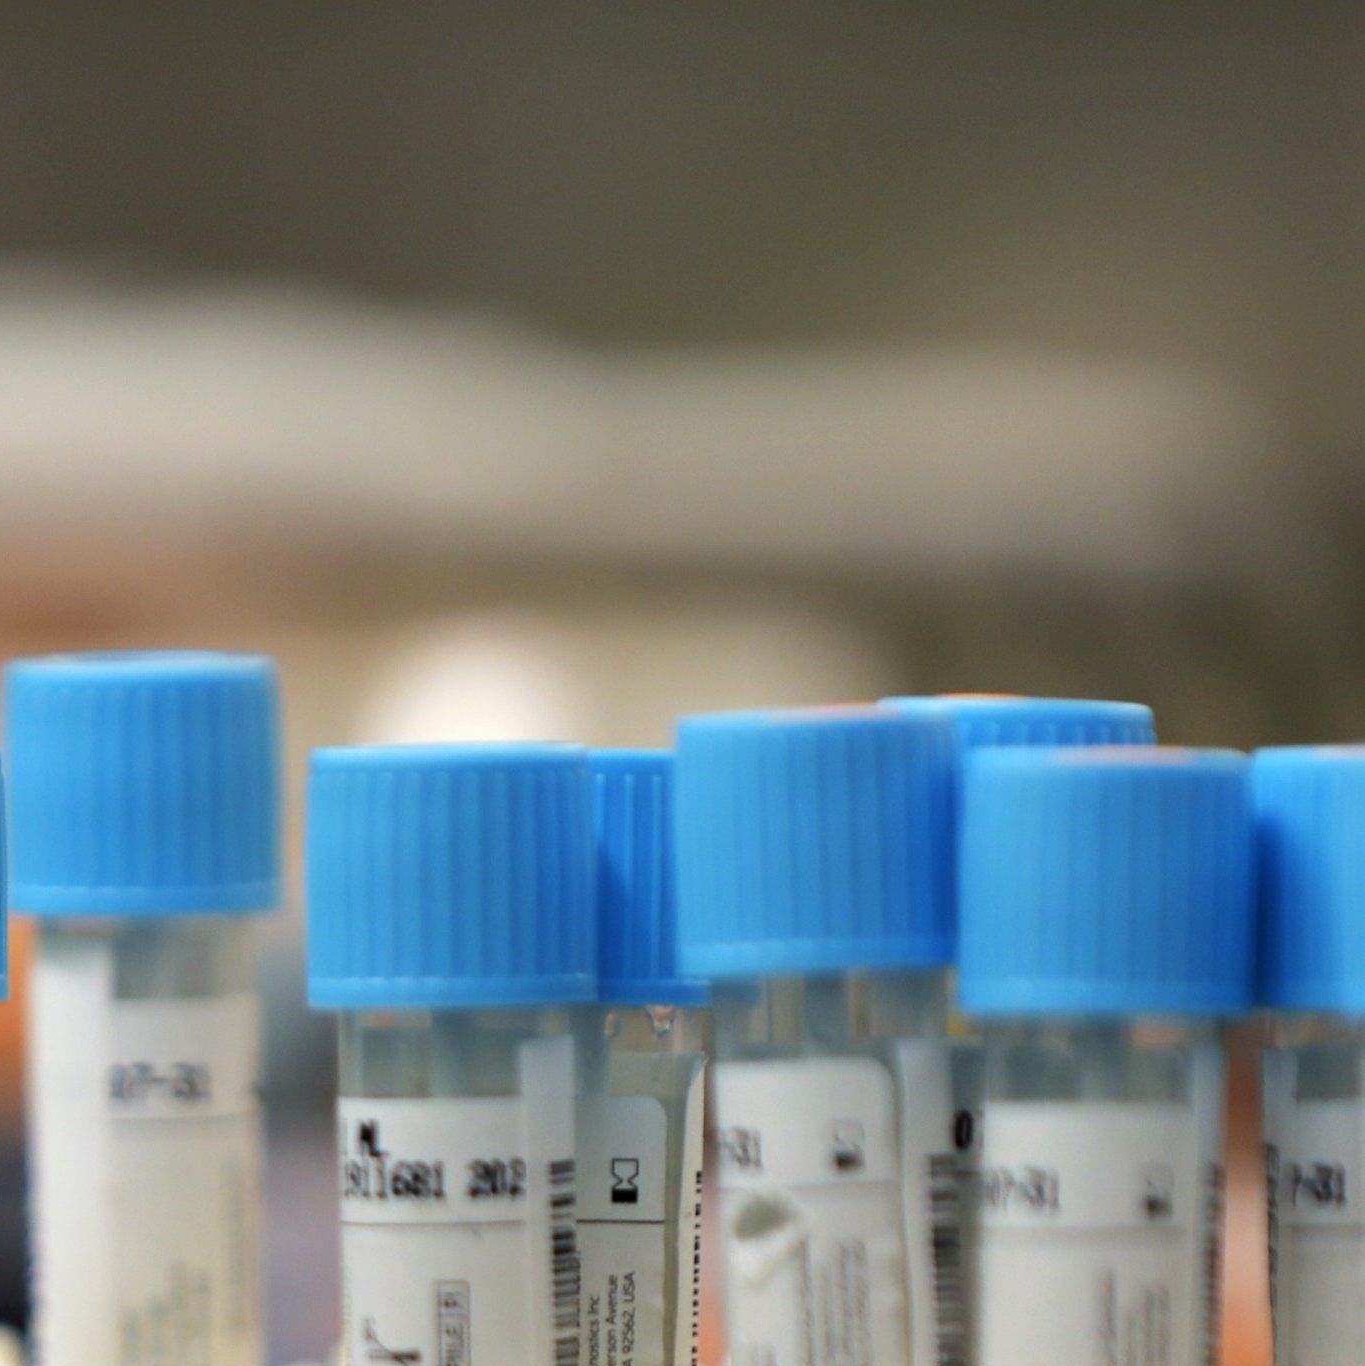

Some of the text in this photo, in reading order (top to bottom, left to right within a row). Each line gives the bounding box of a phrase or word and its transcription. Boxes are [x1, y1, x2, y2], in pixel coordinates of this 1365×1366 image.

[605, 1275, 618, 1325] Avenue
[622, 1271, 635, 1303] USA
[587, 1296, 599, 1314] Inc
